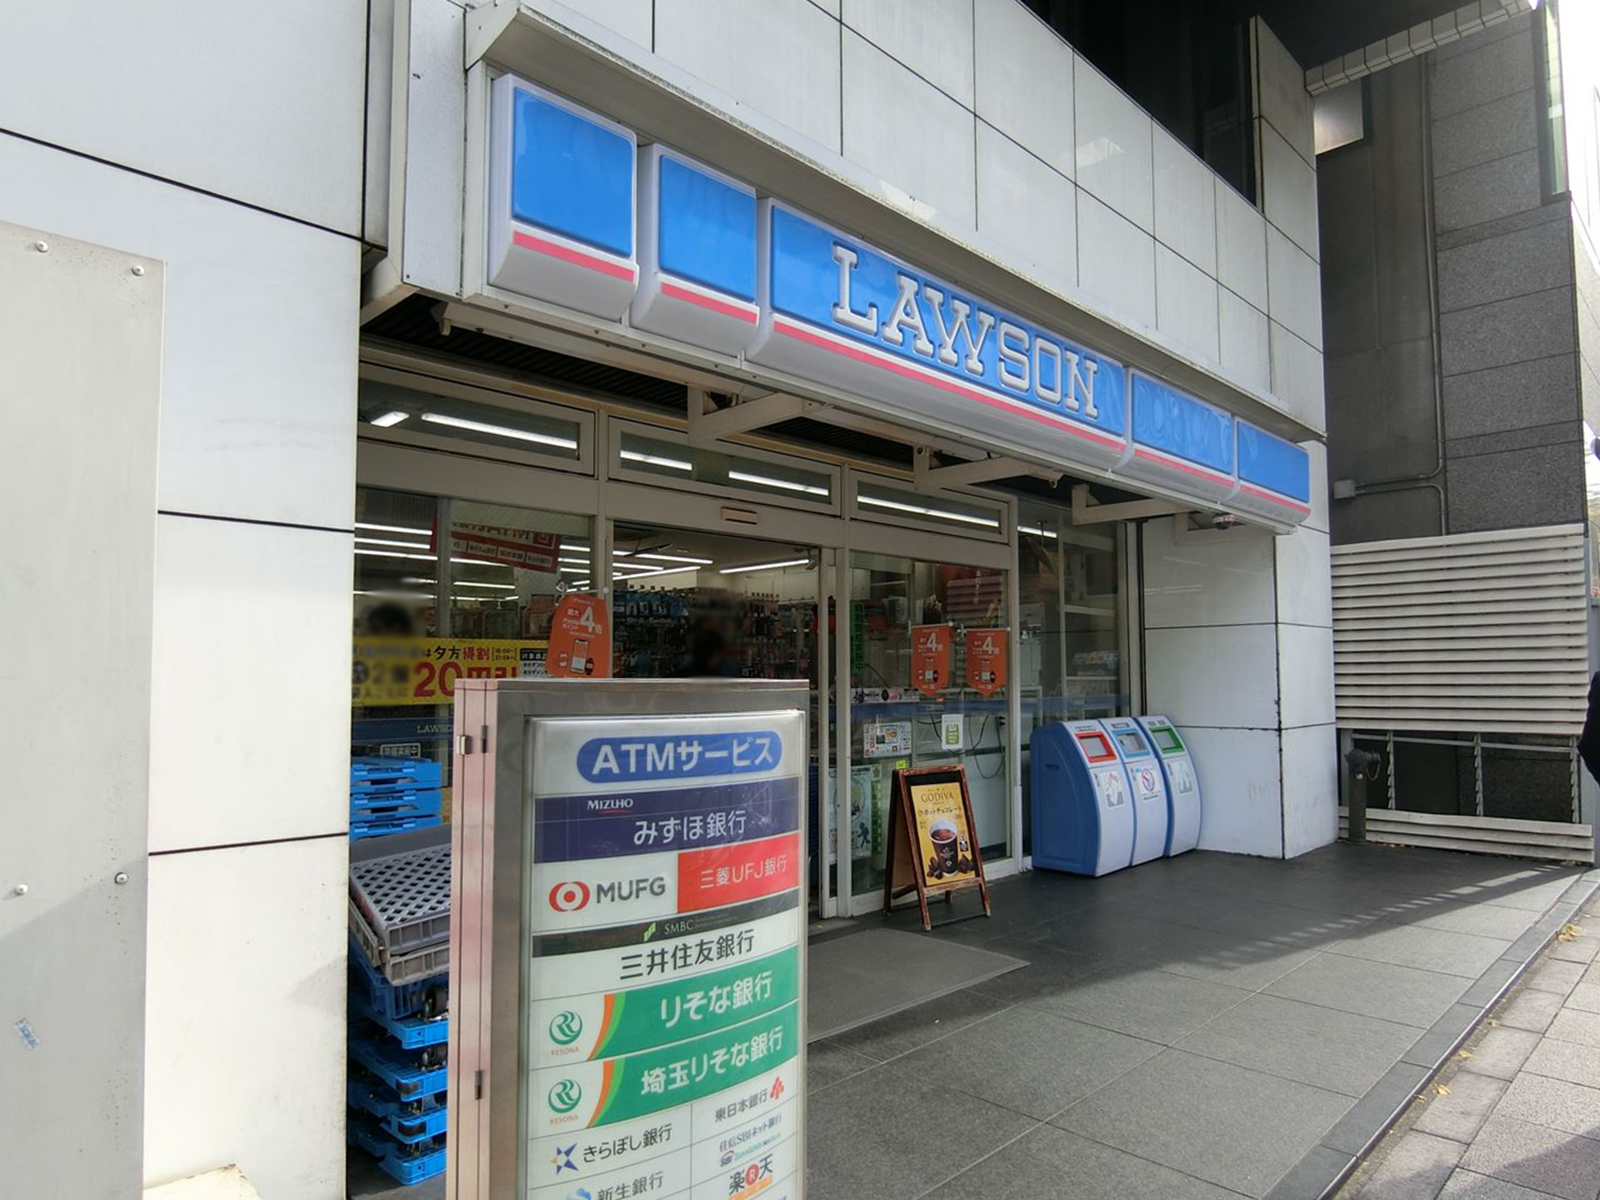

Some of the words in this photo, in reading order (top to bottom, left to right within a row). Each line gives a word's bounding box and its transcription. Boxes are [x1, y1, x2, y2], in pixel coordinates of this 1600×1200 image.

[832, 241, 1098, 420] LAWSON
[591, 737, 775, 775] ATMサービス
[587, 798, 634, 811] MIZUHO
[920, 791, 954, 803] GODIVA
[633, 810, 747, 845] みずほ銀行
[596, 876, 666, 904] MUFG
[700, 855, 788, 890] 三菱UFJ銀行
[664, 919, 695, 935] SMBC
[619, 929, 755, 980] 三井住友銀行
[660, 971, 773, 1028] りそな銀行
[641, 1025, 784, 1095] 埼玉りそな銀行
[583, 1123, 673, 1163] きらぼし銀行
[715, 1088, 768, 1123] 東日本銀行
[597, 1171, 664, 1200] 新生銀行
